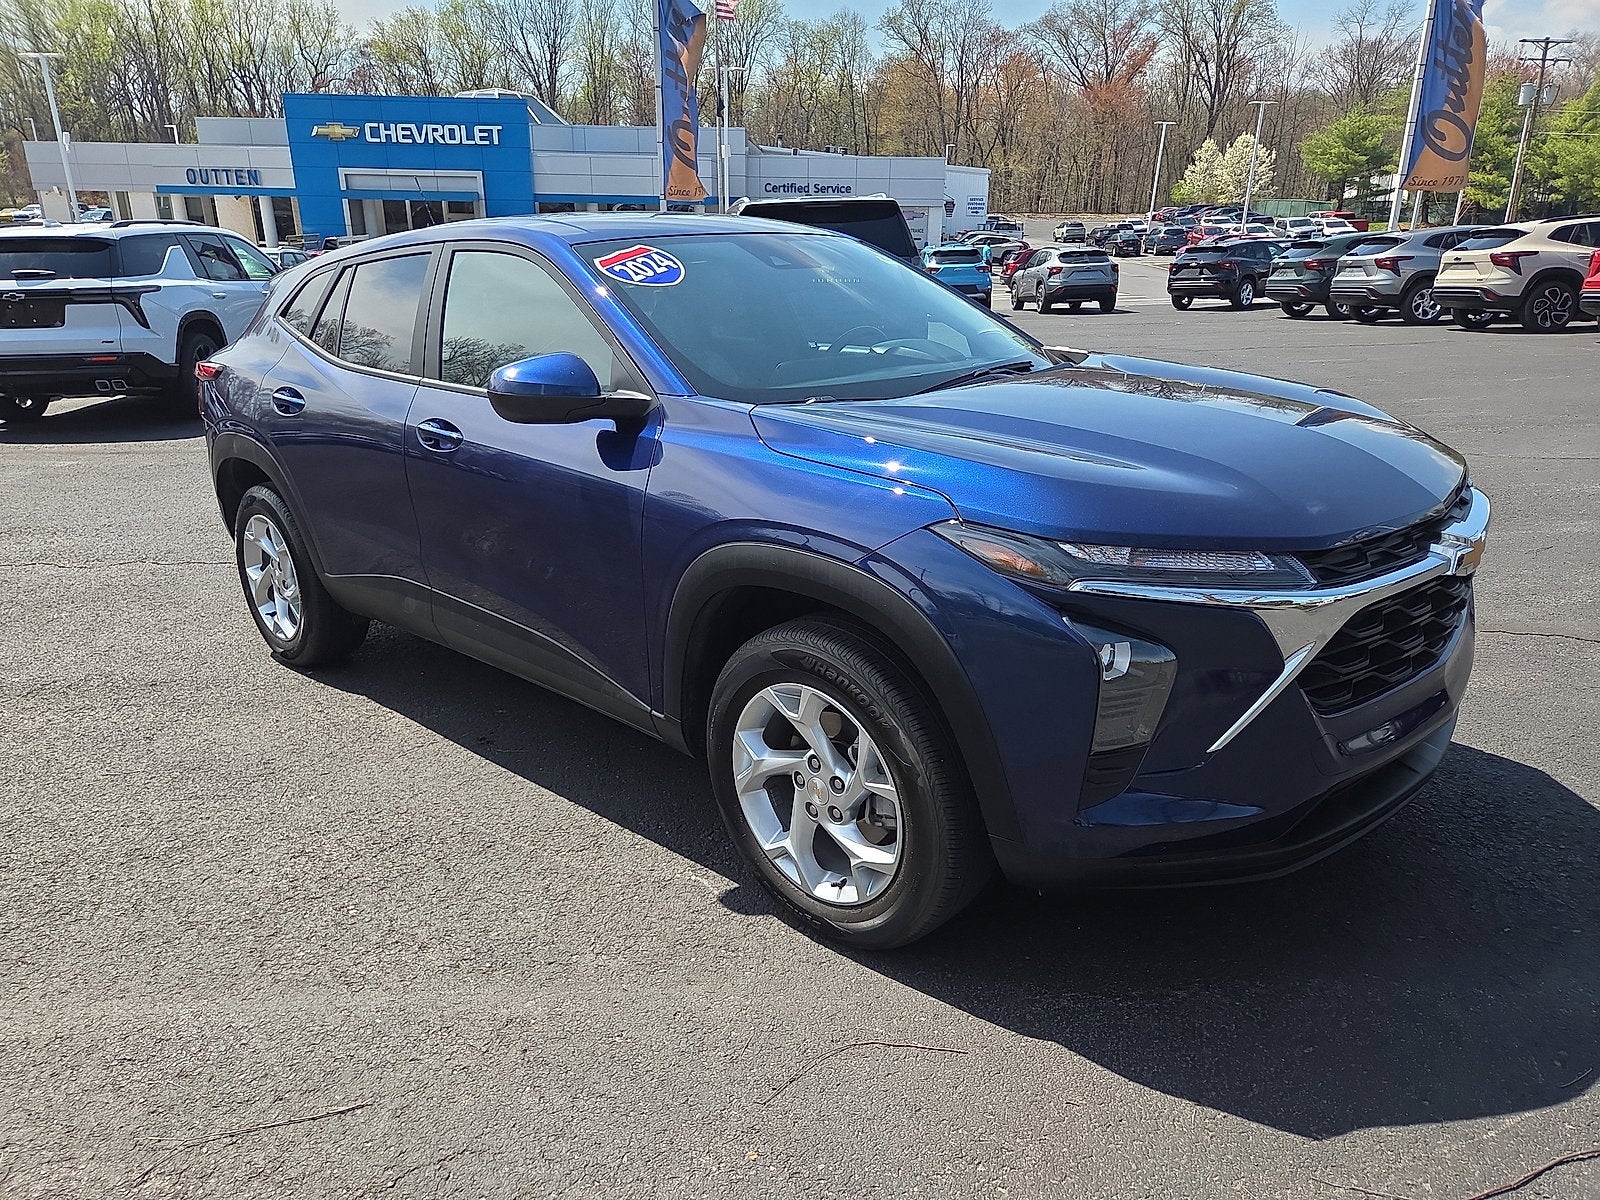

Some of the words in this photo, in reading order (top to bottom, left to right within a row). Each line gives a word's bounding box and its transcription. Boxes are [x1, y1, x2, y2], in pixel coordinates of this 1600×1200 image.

[364, 122, 503, 146] CHEVROLET
[185, 167, 261, 186] OUTTEN
[1408, 175, 1438, 187] Since
[1441, 175, 1465, 187] 1979
[668, 184, 691, 197] Since
[764, 182, 810, 194] Certified
[813, 183, 852, 194] Service
[612, 252, 679, 282] 2024
